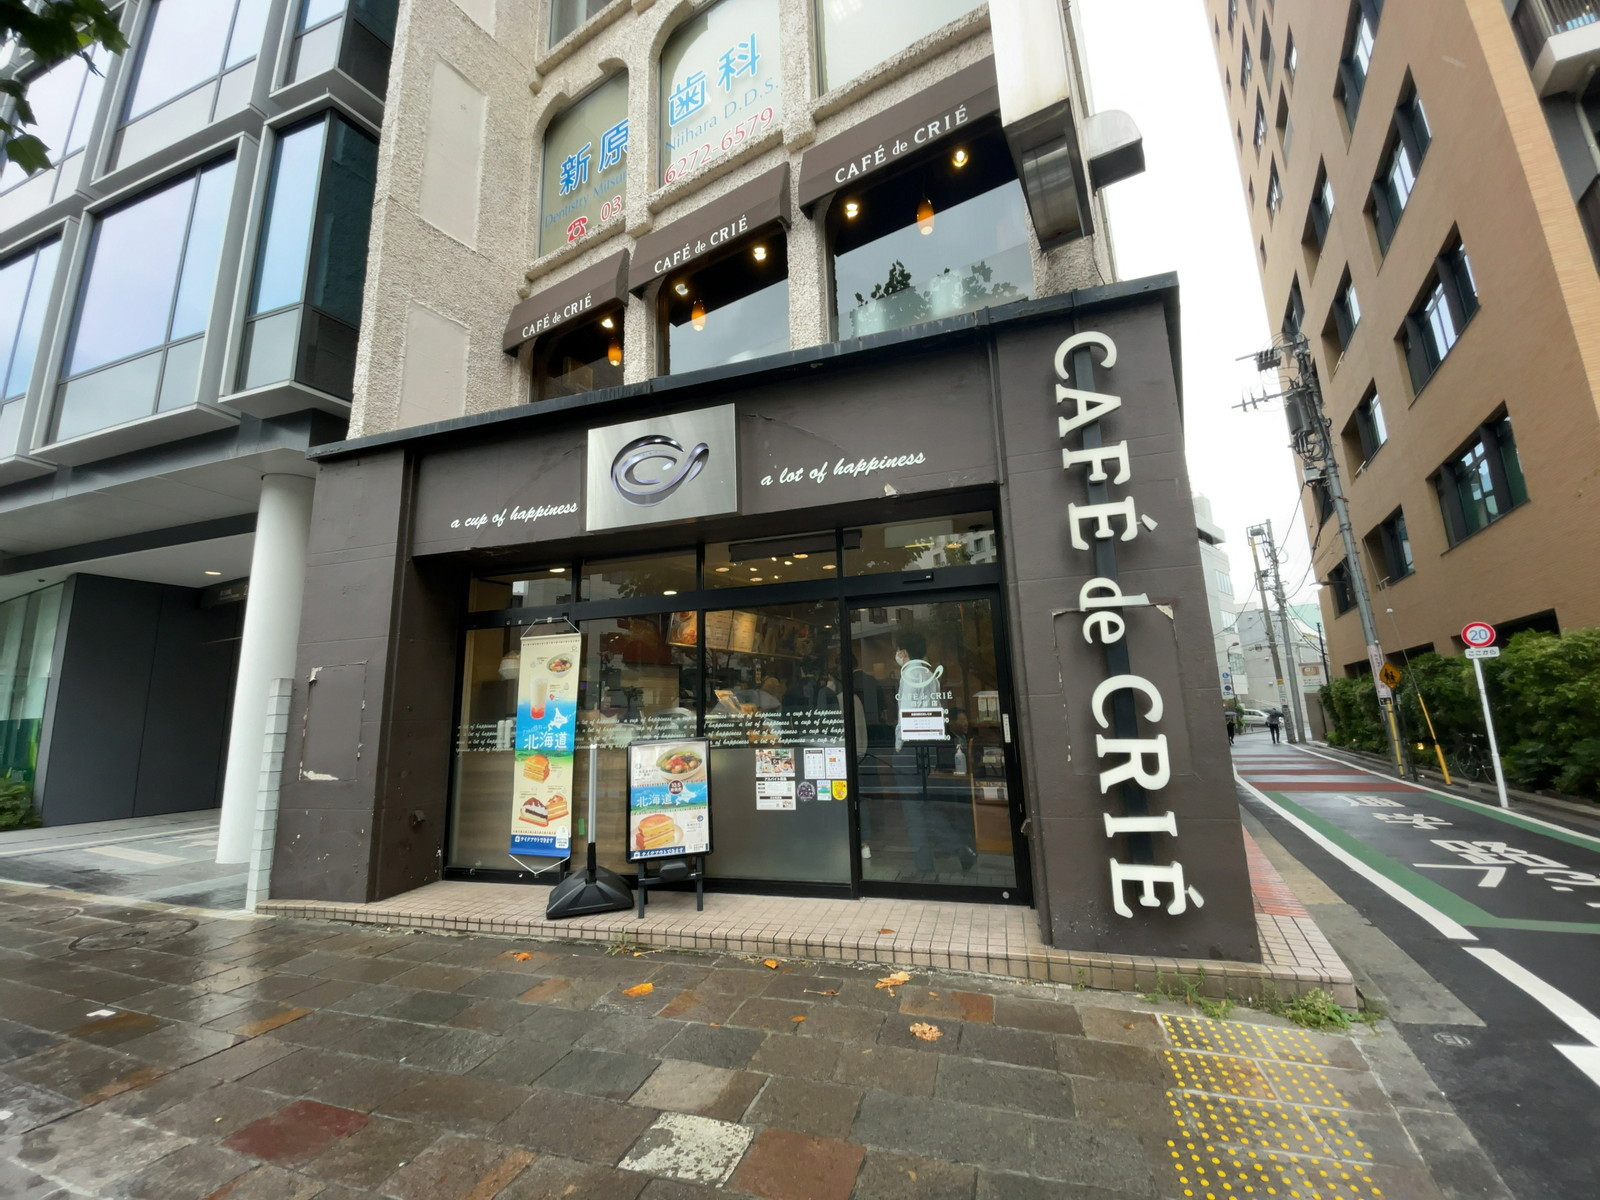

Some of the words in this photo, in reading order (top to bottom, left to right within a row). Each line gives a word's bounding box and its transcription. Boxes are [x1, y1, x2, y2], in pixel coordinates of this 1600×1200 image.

[669, 33, 761, 127] 歯科
[663, 115, 717, 151] Niihara
[724, 77, 779, 120] D.D.S.
[559, 118, 629, 196] 新原
[664, 107, 774, 185] 6272-6579
[834, 143, 886, 185] CAFÉ
[891, 139, 909, 157] de
[913, 104, 969, 145] CRIÉ
[544, 194, 589, 228] Dentistry
[600, 195, 622, 222] 03
[654, 241, 691, 275] CAFÉ
[694, 239, 707, 255] de
[709, 214, 749, 248] CRIÉ
[521, 314, 550, 339] CAFÉ
[552, 311, 562, 325] de
[563, 293, 593, 319] CRIÉ
[1054, 331, 1159, 551] CAFÉ
[761, 473, 773, 486] a
[779, 466, 803, 484] lot
[809, 462, 828, 483] of
[833, 452, 927, 477] happiness
[450, 519, 460, 529] a
[464, 513, 488, 529] cup
[491, 509, 507, 527] of
[510, 502, 578, 523] happiness
[1079, 577, 1151, 646] de
[1469, 629, 1488, 641] 20
[930, 690, 953, 700] CRIÉ
[523, 731, 568, 750] 北海道
[636, 793, 672, 807] 北海道
[1092, 674, 1205, 919] CRIÉ
